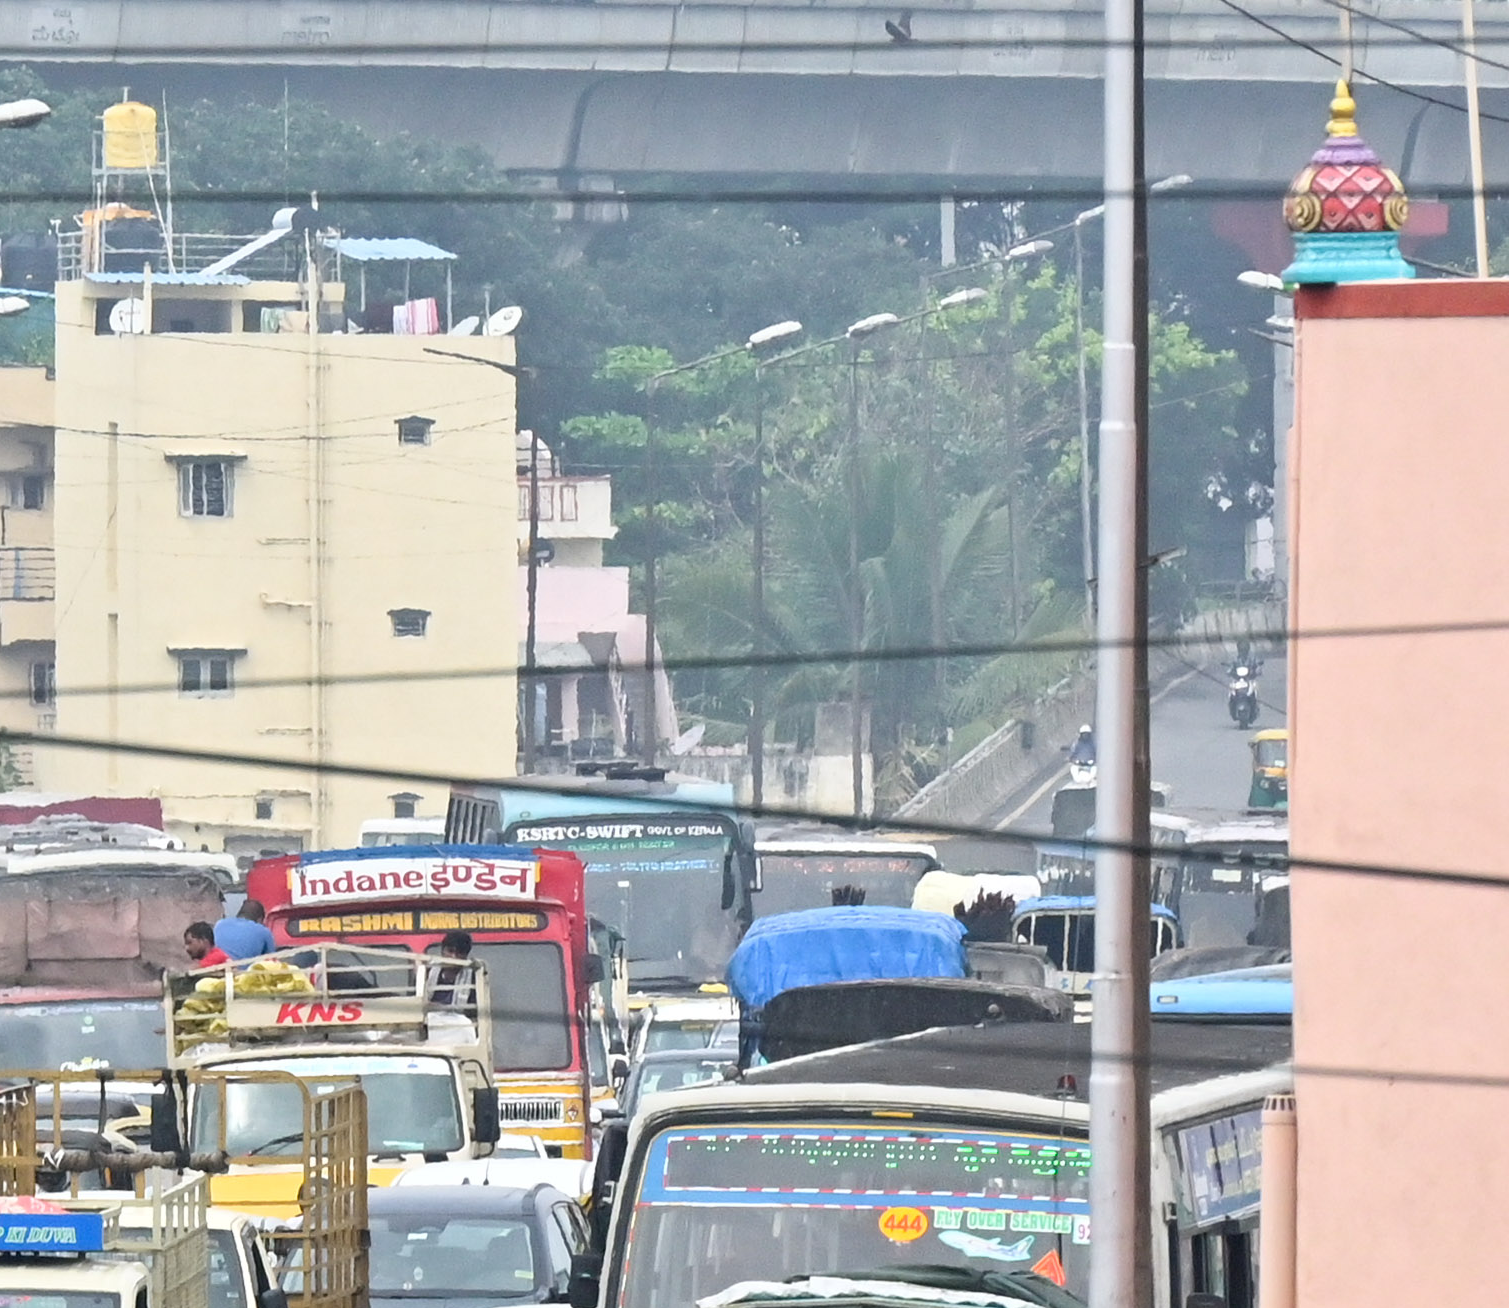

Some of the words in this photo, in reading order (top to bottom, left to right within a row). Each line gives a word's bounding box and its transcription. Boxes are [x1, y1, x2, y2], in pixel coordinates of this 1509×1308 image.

[516, 823, 644, 844] KSRTC-SWIFT
[299, 870, 424, 898] Indane
[430, 858, 532, 894] इण्डेन
[298, 912, 414, 933] RASHMI
[276, 1001, 365, 1025] KNS
[882, 1214, 923, 1233] 444
[934, 1209, 962, 1228] FLY
[967, 1210, 1006, 1231] OVER
[1011, 1212, 1072, 1233] SERVICE
[5, 1226, 27, 1244] KI
[27, 1226, 78, 1244] DUWA
